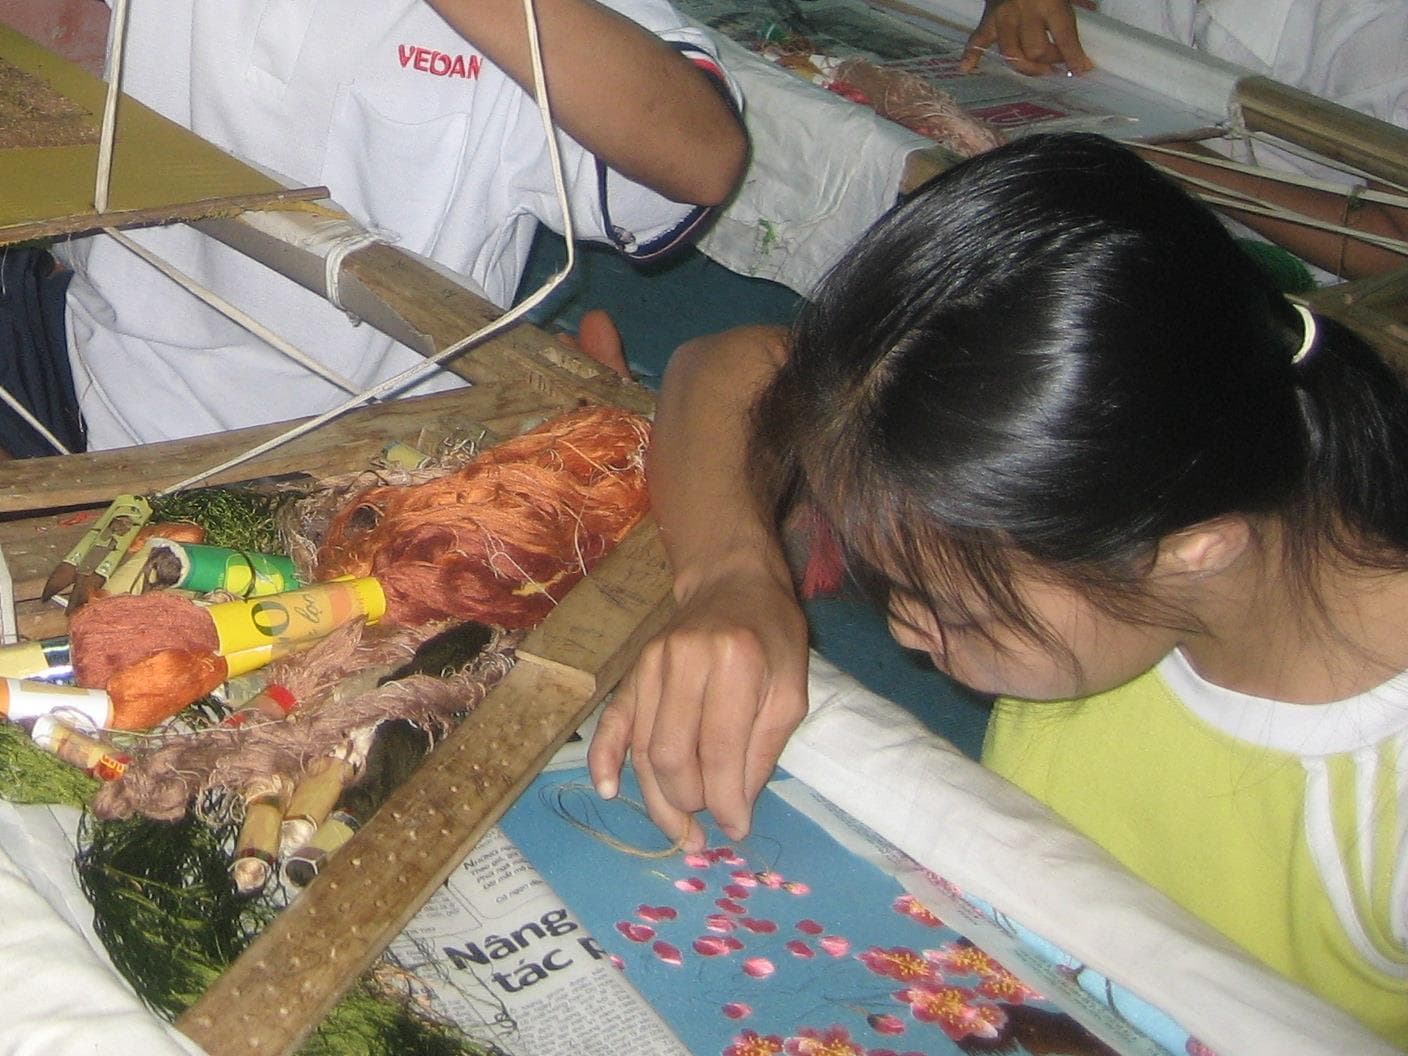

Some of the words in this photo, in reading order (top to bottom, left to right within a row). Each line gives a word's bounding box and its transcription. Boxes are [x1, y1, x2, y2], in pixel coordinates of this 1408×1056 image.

[398, 44, 483, 81] VEDAN
[442, 908, 578, 970] Nâng
[491, 948, 574, 993] tác
